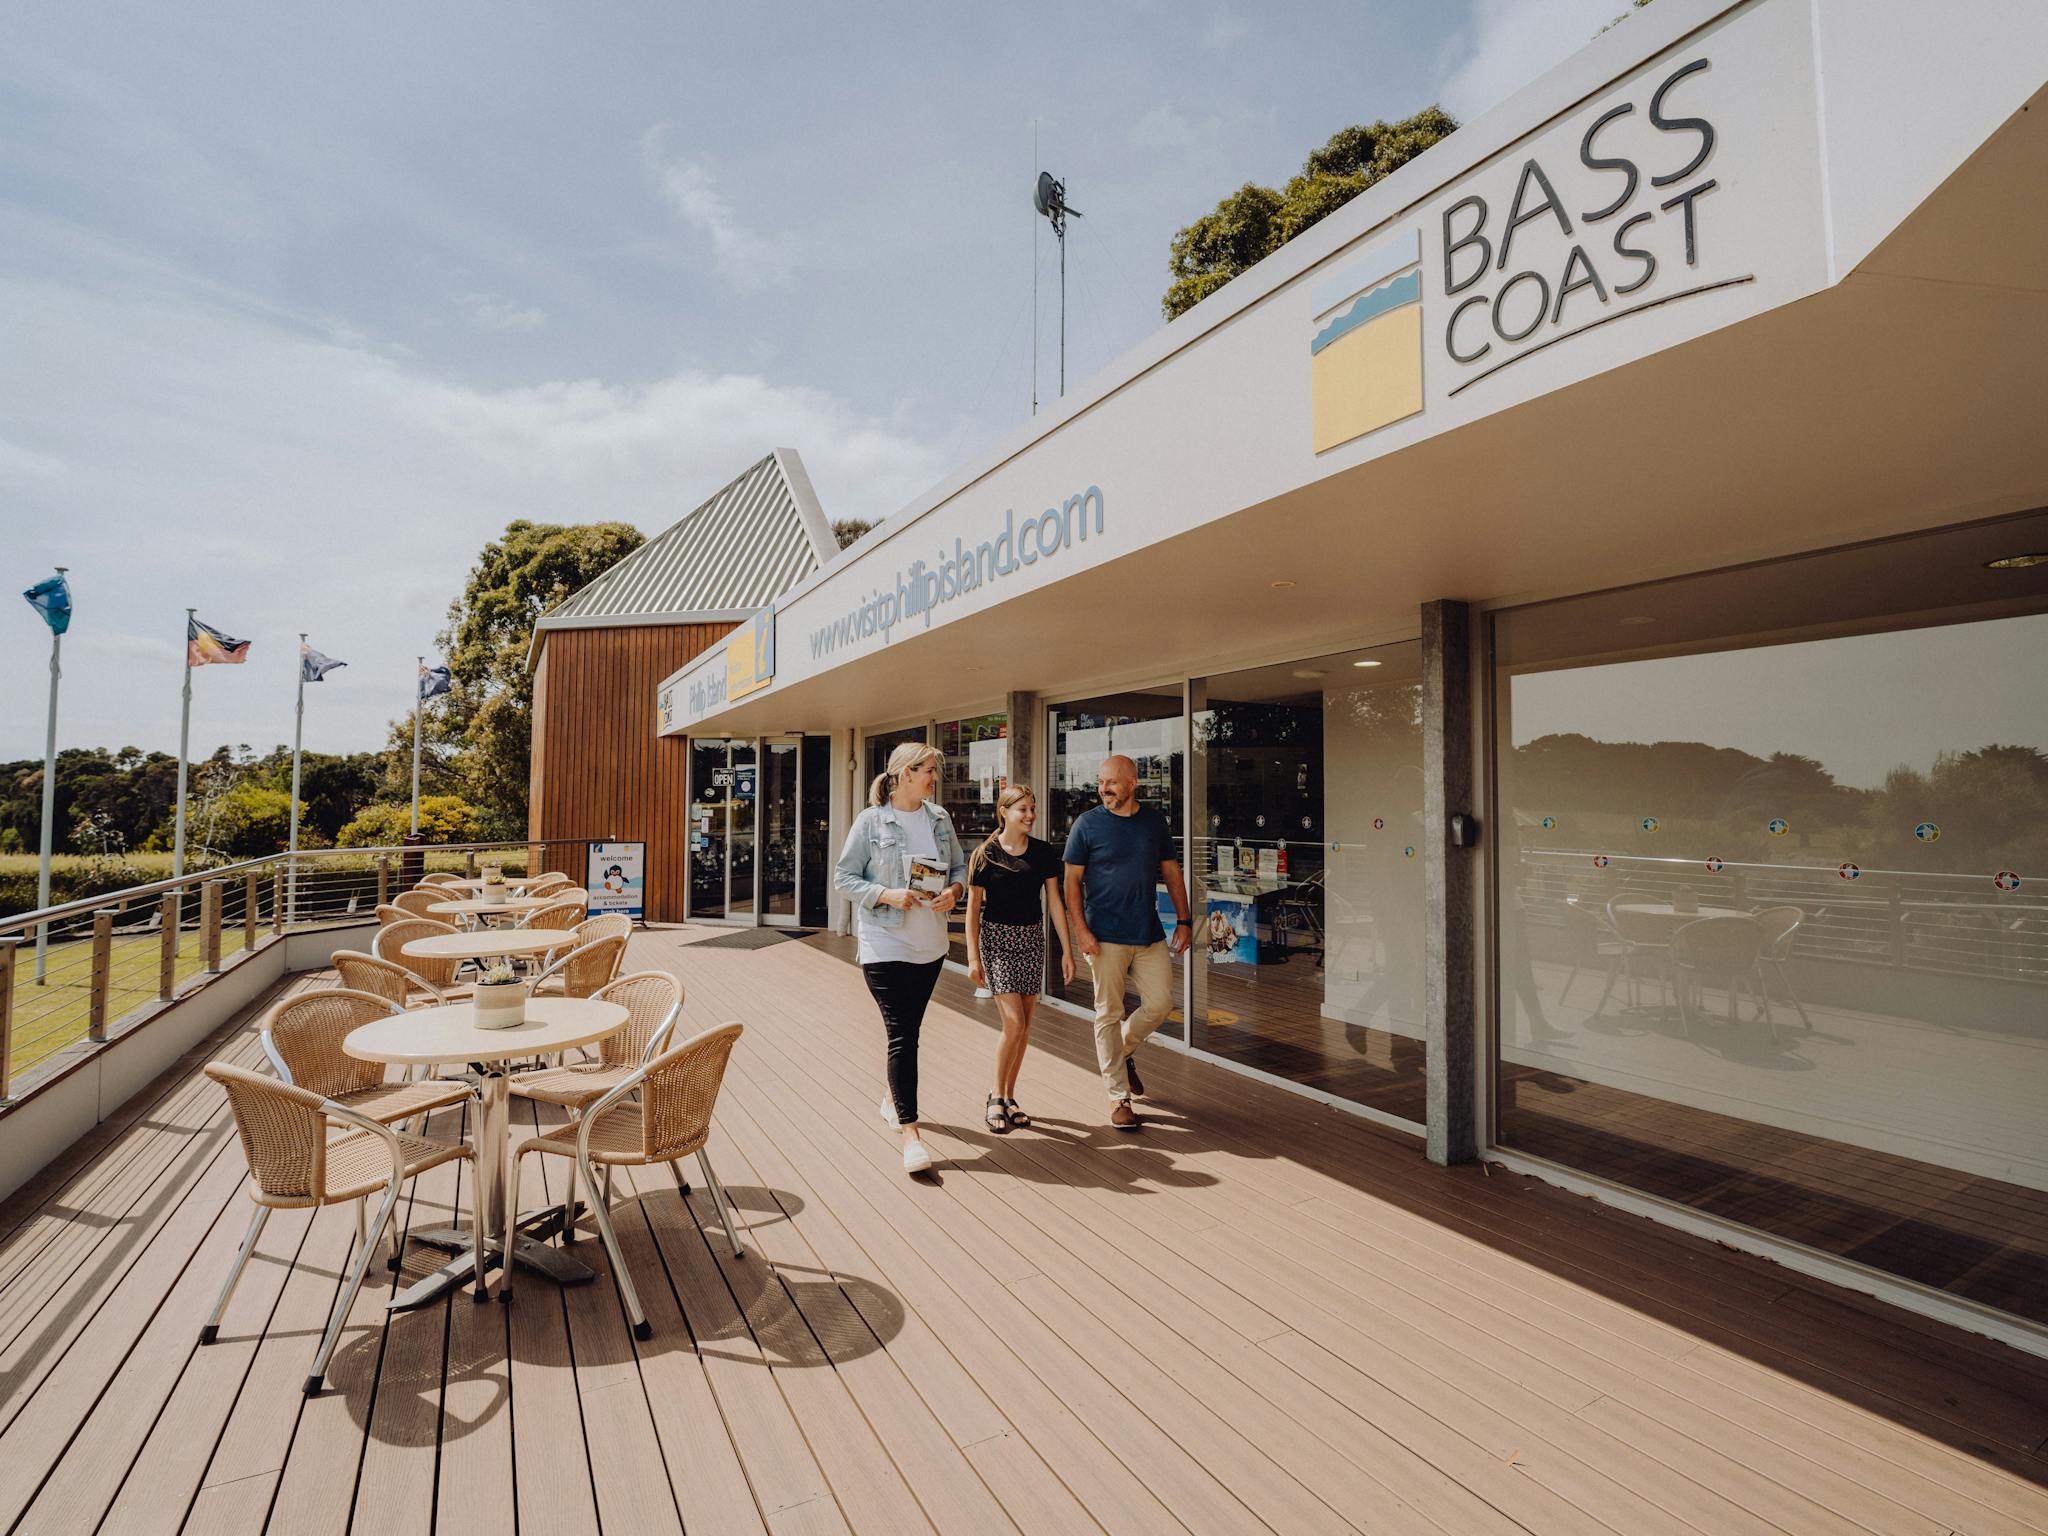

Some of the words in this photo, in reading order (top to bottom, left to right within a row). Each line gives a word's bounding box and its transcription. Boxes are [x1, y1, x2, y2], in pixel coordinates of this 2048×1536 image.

[1442, 58, 1714, 296] BASS
[1445, 178, 1717, 363] COAST
[809, 484, 1104, 660] www.visitphillipisland.com
[714, 774, 733, 785] OPEN
